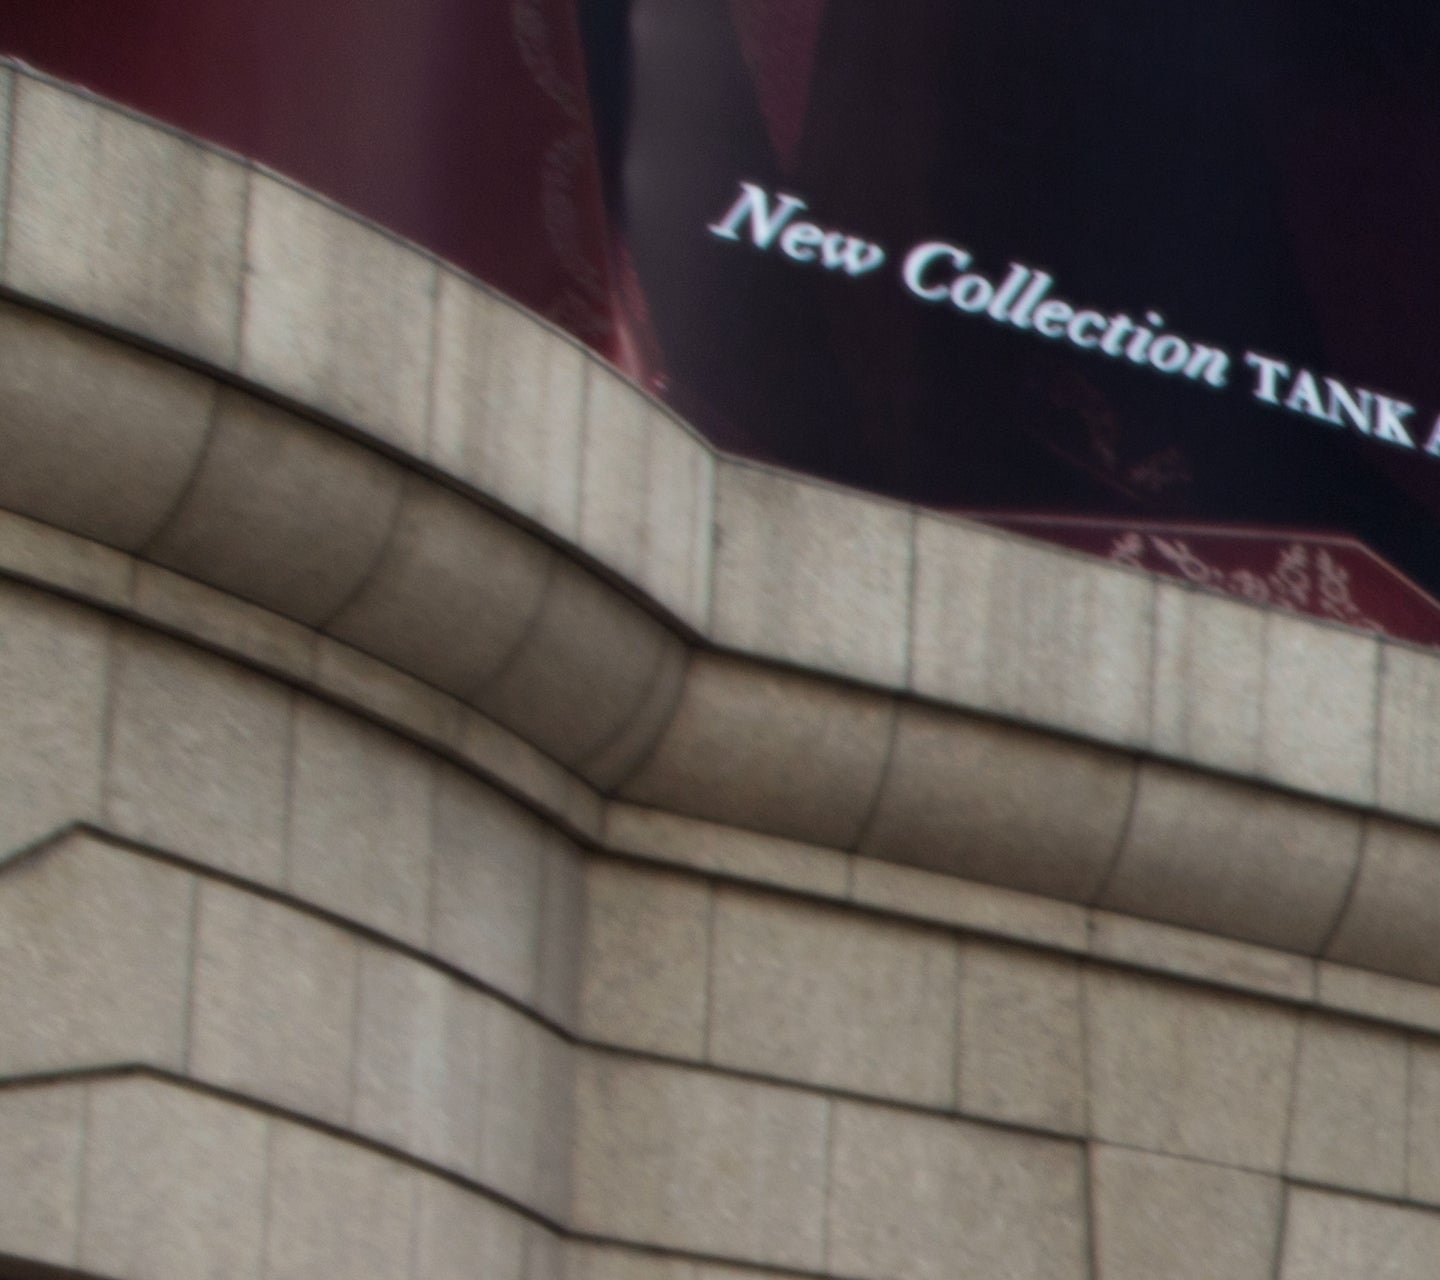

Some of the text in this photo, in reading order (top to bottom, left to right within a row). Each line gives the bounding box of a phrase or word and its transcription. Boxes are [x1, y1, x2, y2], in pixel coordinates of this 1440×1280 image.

[708, 183, 884, 277] New
[903, 239, 1228, 388] Collection
[1246, 352, 1416, 450] TANK
